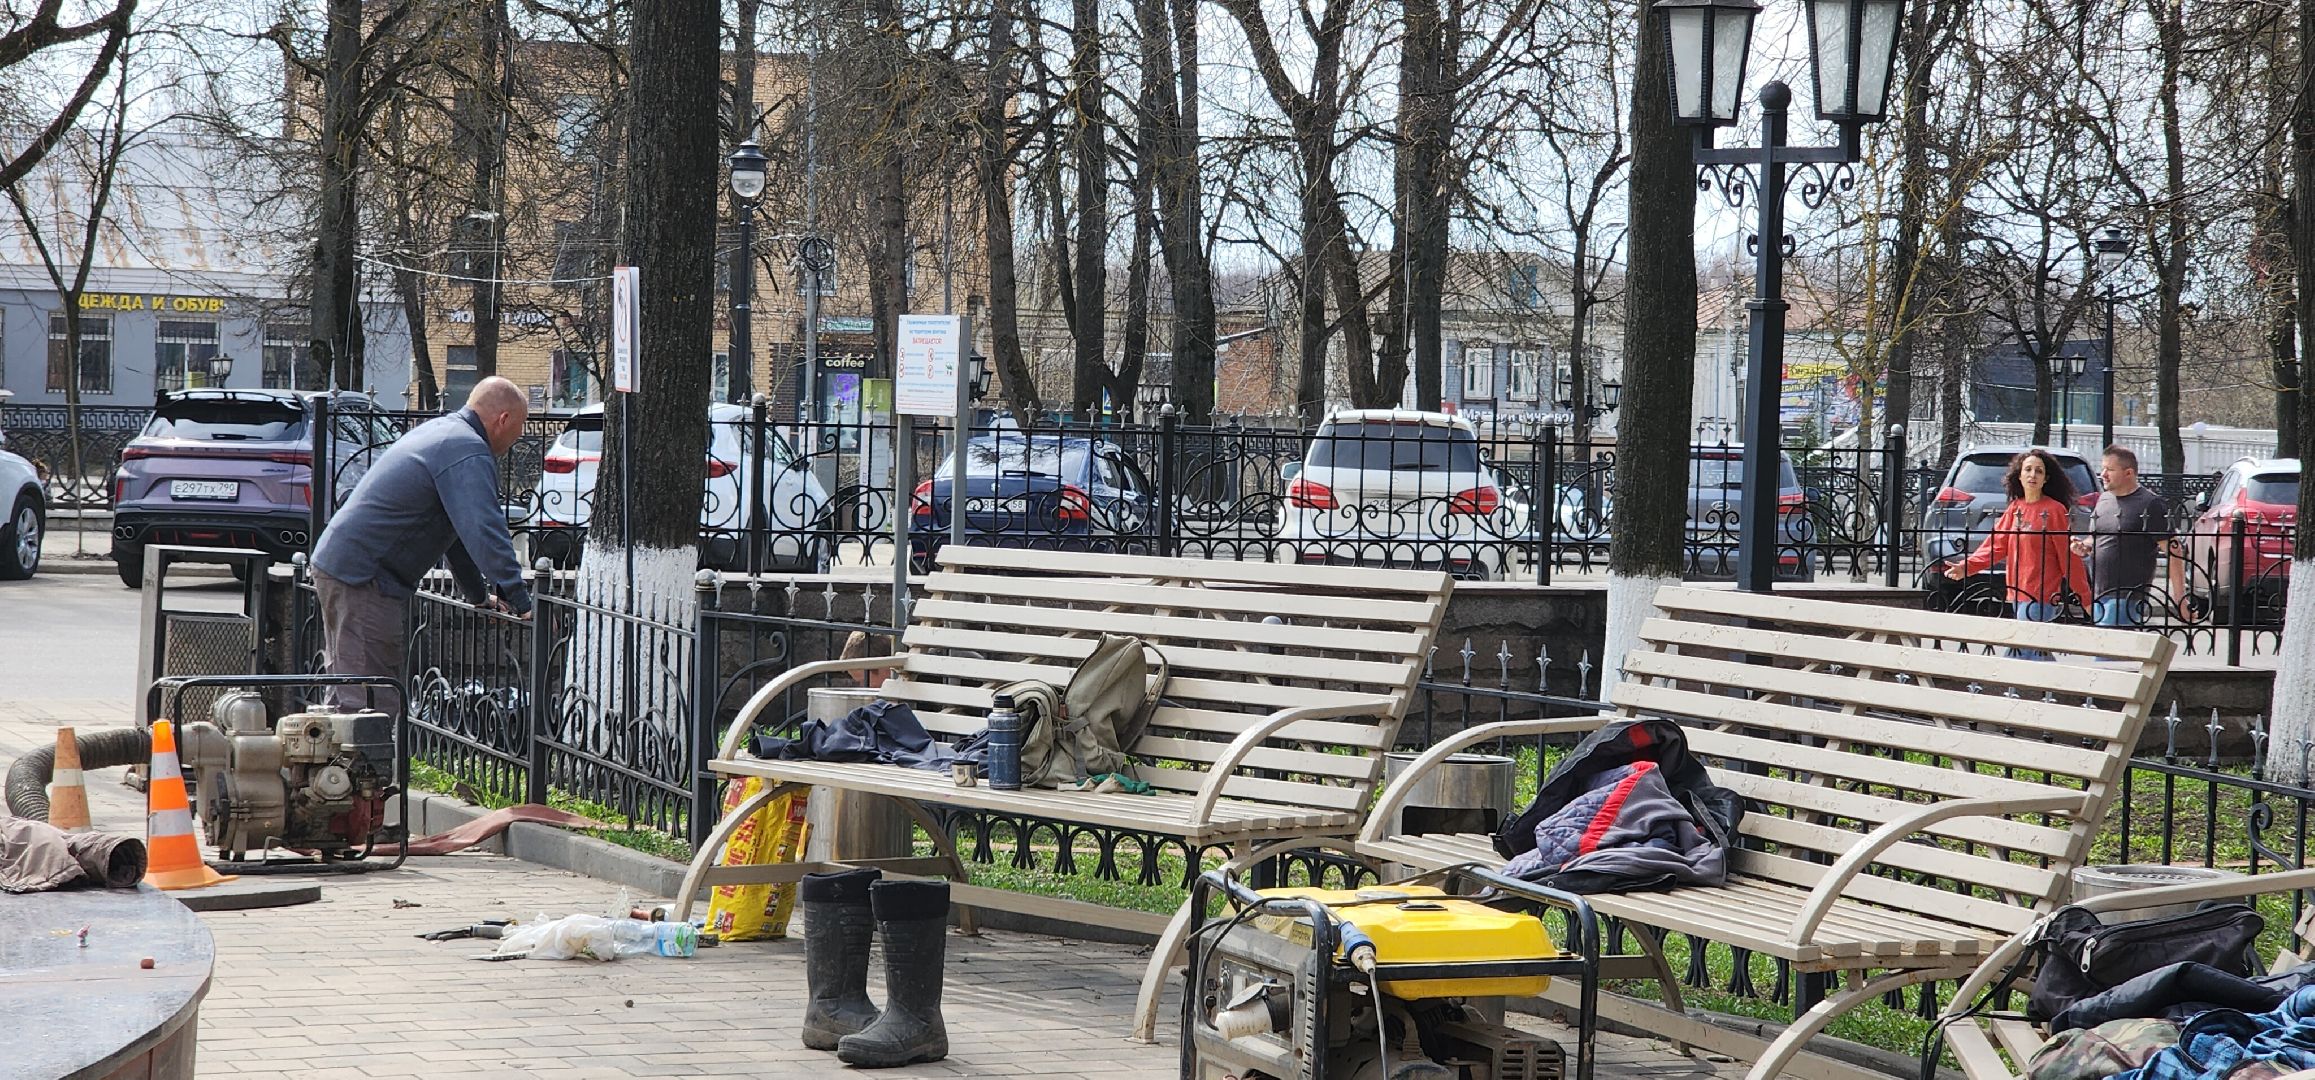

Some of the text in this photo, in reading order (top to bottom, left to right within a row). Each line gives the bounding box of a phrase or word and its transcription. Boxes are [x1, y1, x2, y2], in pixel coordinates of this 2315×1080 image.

[78, 293, 144, 311] ДЕЖДА
[152, 296, 165, 310] И
[825, 353, 865, 368] coffee
[218, 482, 236, 492] 790
